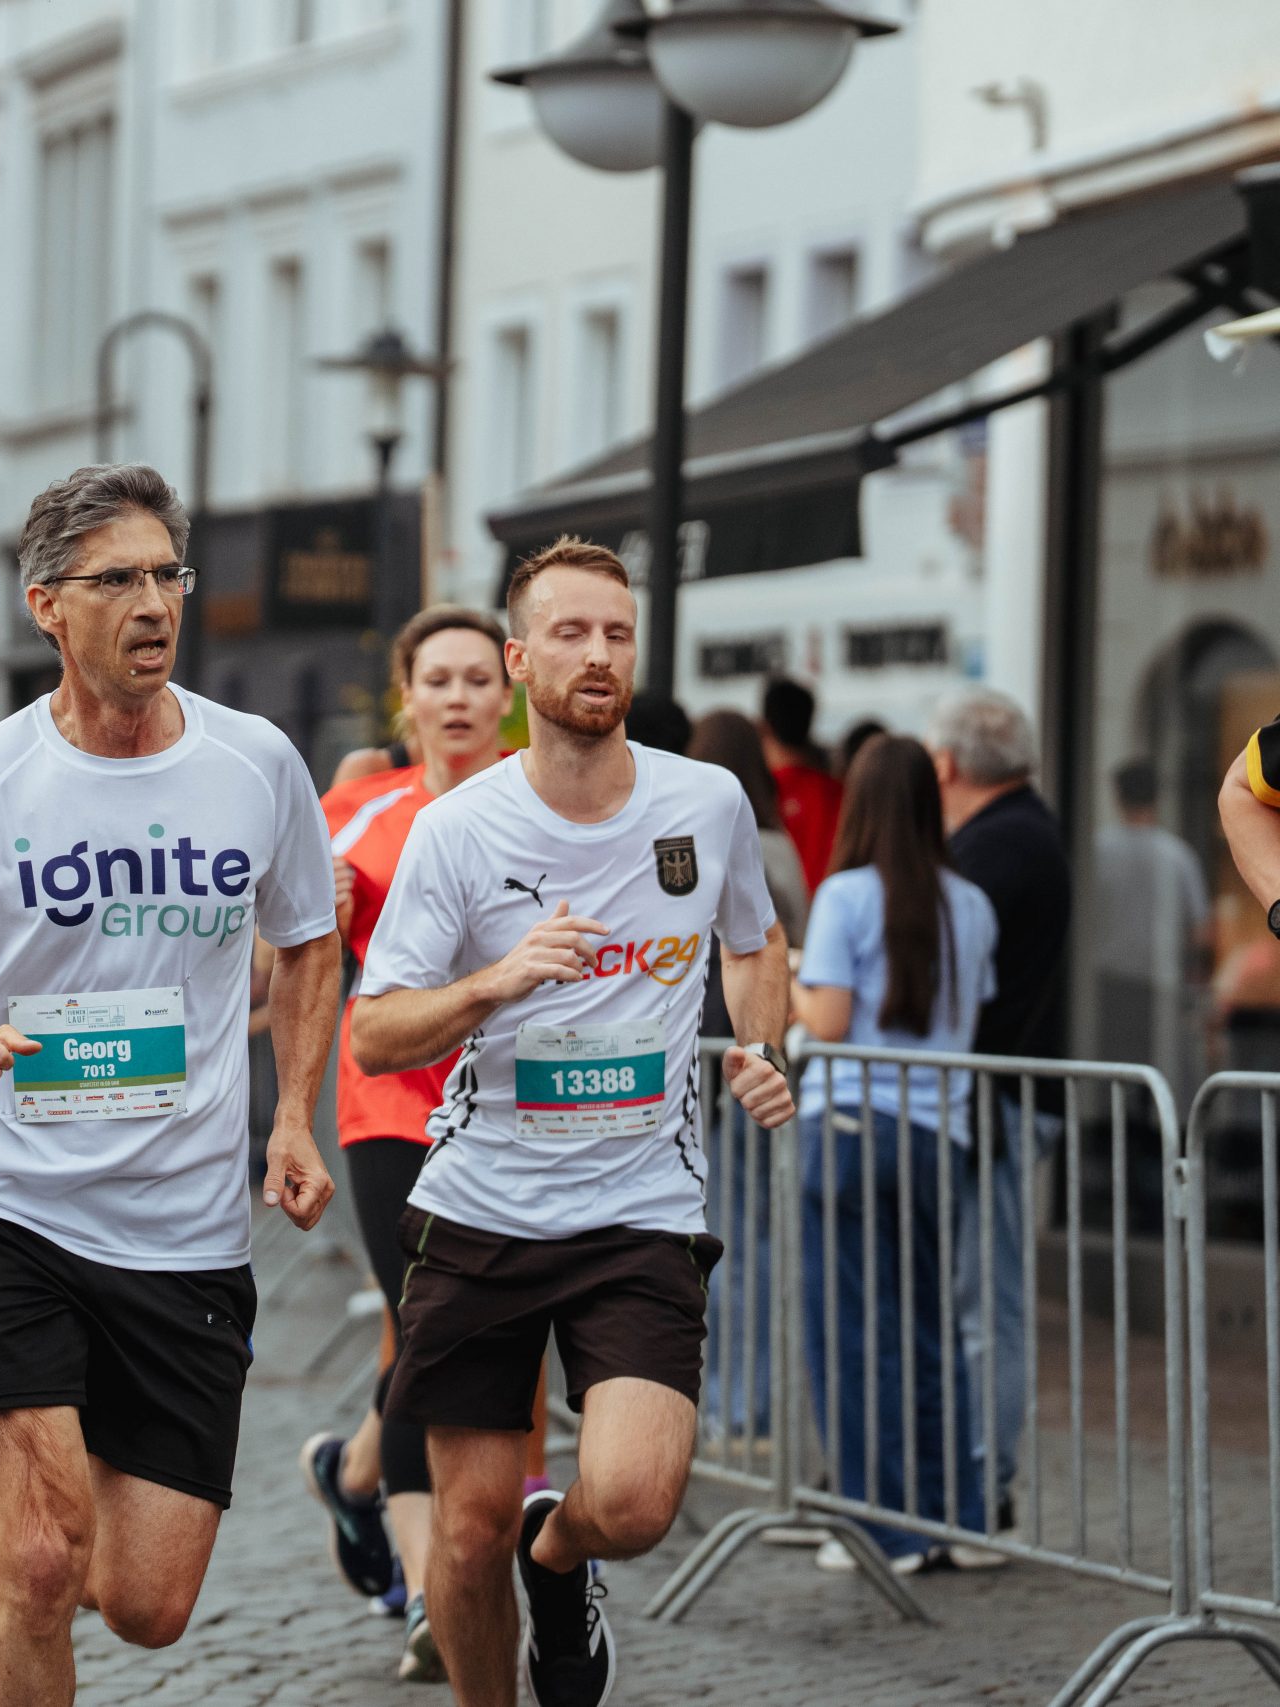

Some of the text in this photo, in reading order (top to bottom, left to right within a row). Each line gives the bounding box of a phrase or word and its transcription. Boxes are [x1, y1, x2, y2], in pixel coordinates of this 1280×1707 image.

[14, 823, 251, 927] ignite
[63, 1038, 131, 1062] Georg
[81, 1063, 116, 1078] 7013
[551, 1066, 636, 1096] 13388
